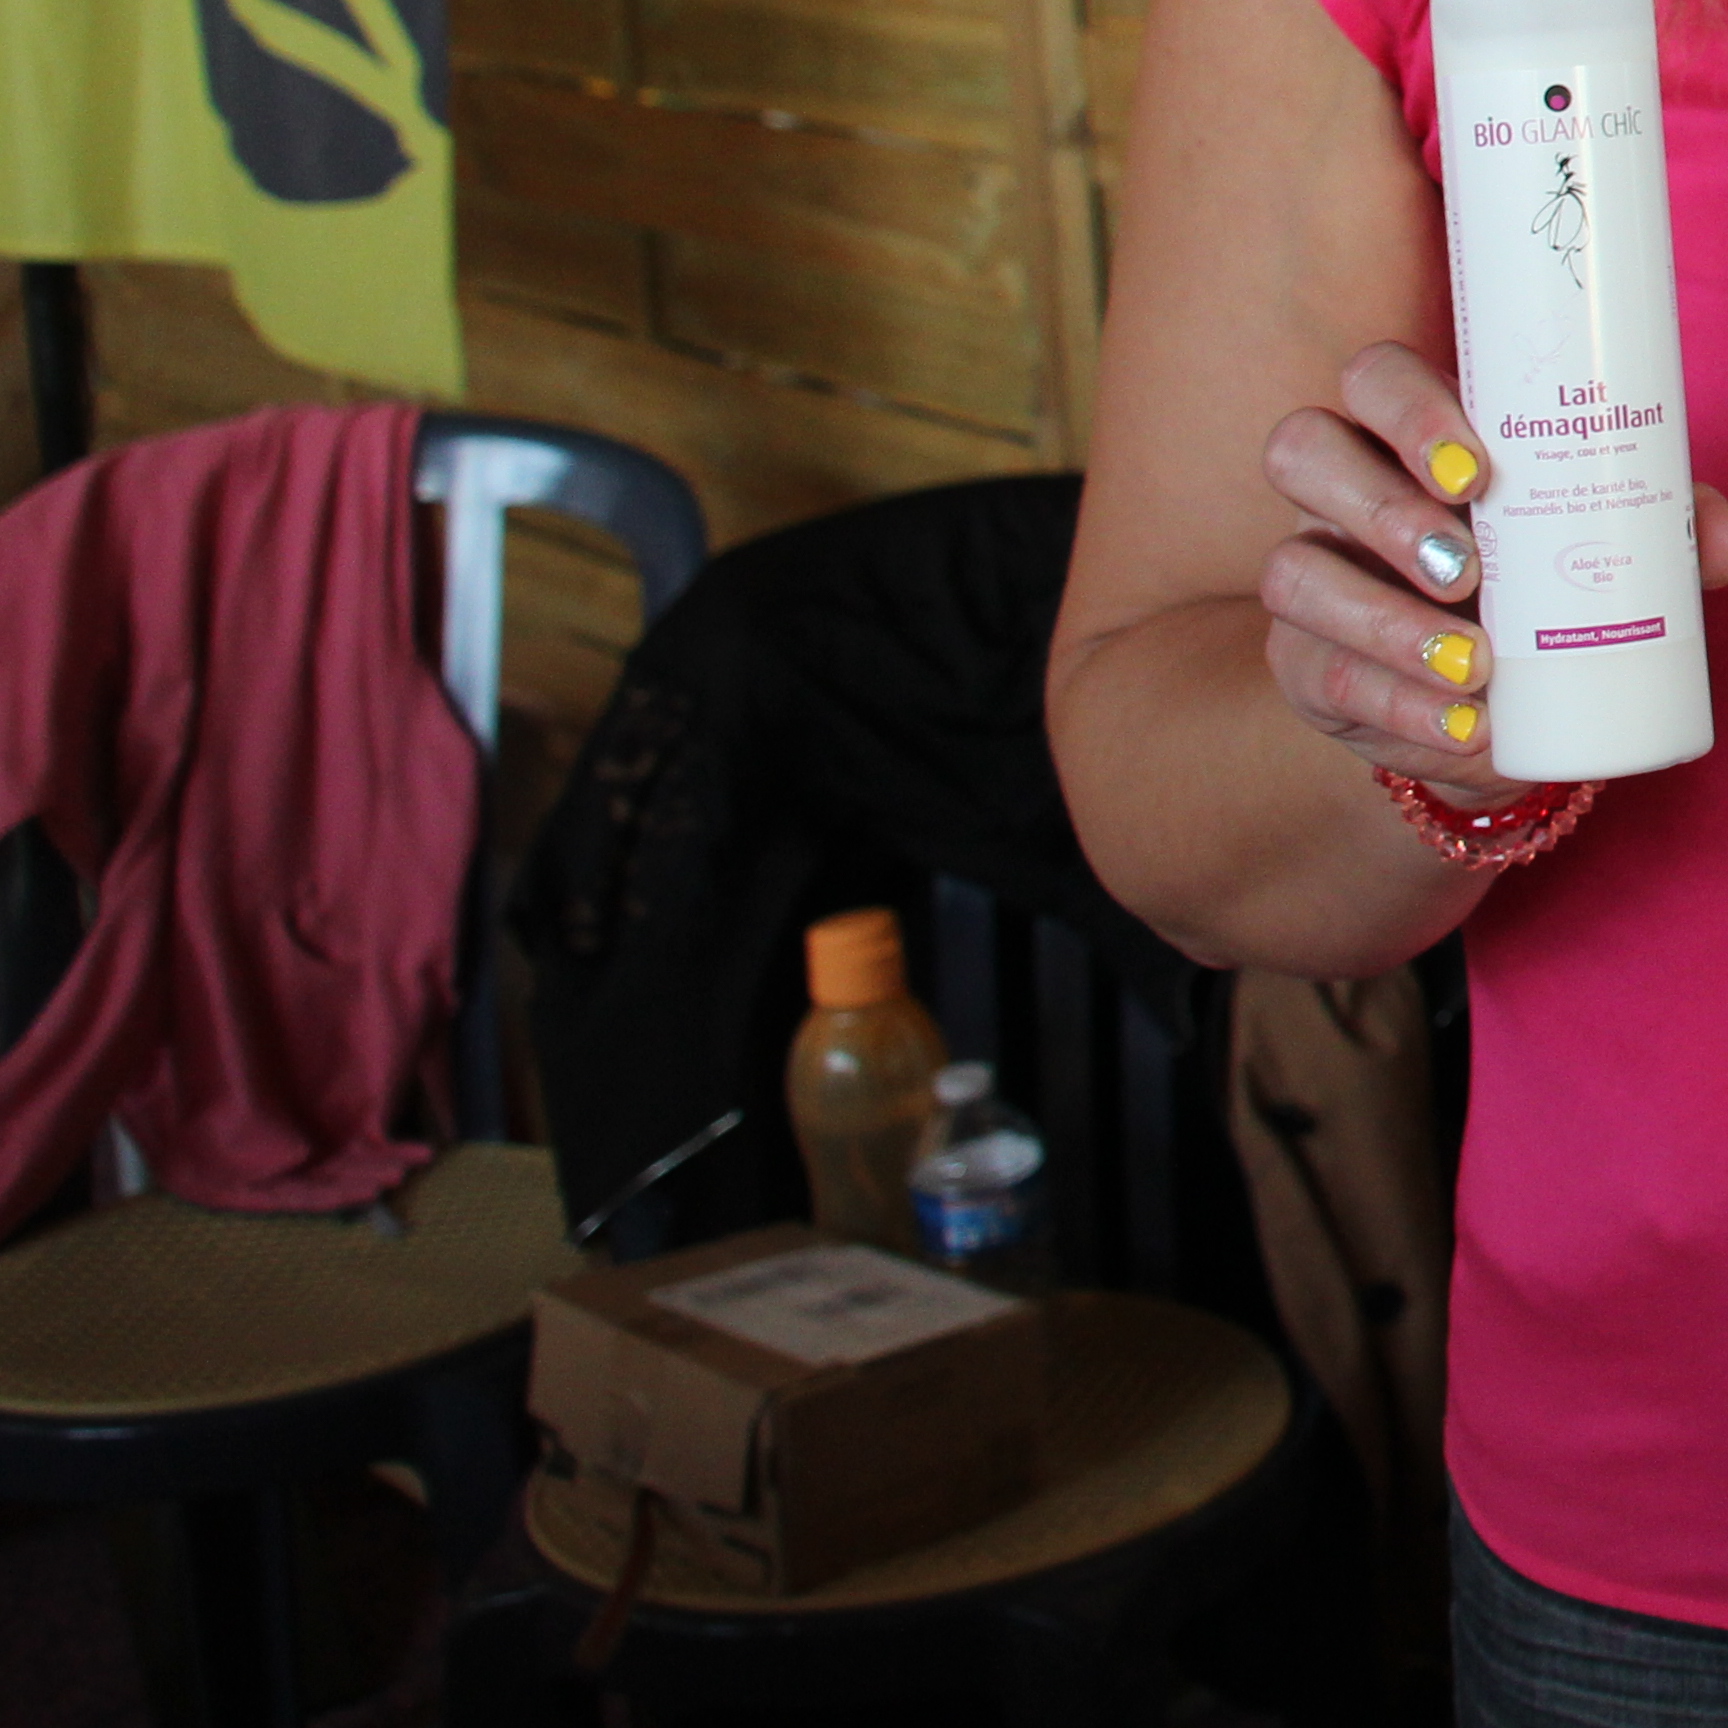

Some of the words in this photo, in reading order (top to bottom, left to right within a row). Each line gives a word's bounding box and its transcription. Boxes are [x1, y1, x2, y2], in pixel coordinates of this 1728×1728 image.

[1521, 116, 1594, 144] GLAM
[1557, 379, 1609, 407] Lait
[1499, 401, 1664, 440] démaquillant
[1534, 447, 1574, 462] Visage,
[1577, 446, 1597, 458] cou
[1600, 443, 1610, 456] et
[1613, 441, 1638, 457] yeux
[1529, 485, 1568, 501] Beurre
[1573, 483, 1588, 498] de
[1592, 480, 1626, 495] karité
[1503, 500, 1563, 517] Hamamélis
[1567, 498, 1586, 513] bio
[1590, 497, 1602, 511] et
[1571, 557, 1601, 571] Aloé
[1605, 553, 1633, 568] Véra
[1594, 571, 1614, 583] Bio
[1540, 633, 1599, 646] Hydratant,
[1602, 622, 1662, 640] Nourrissant
